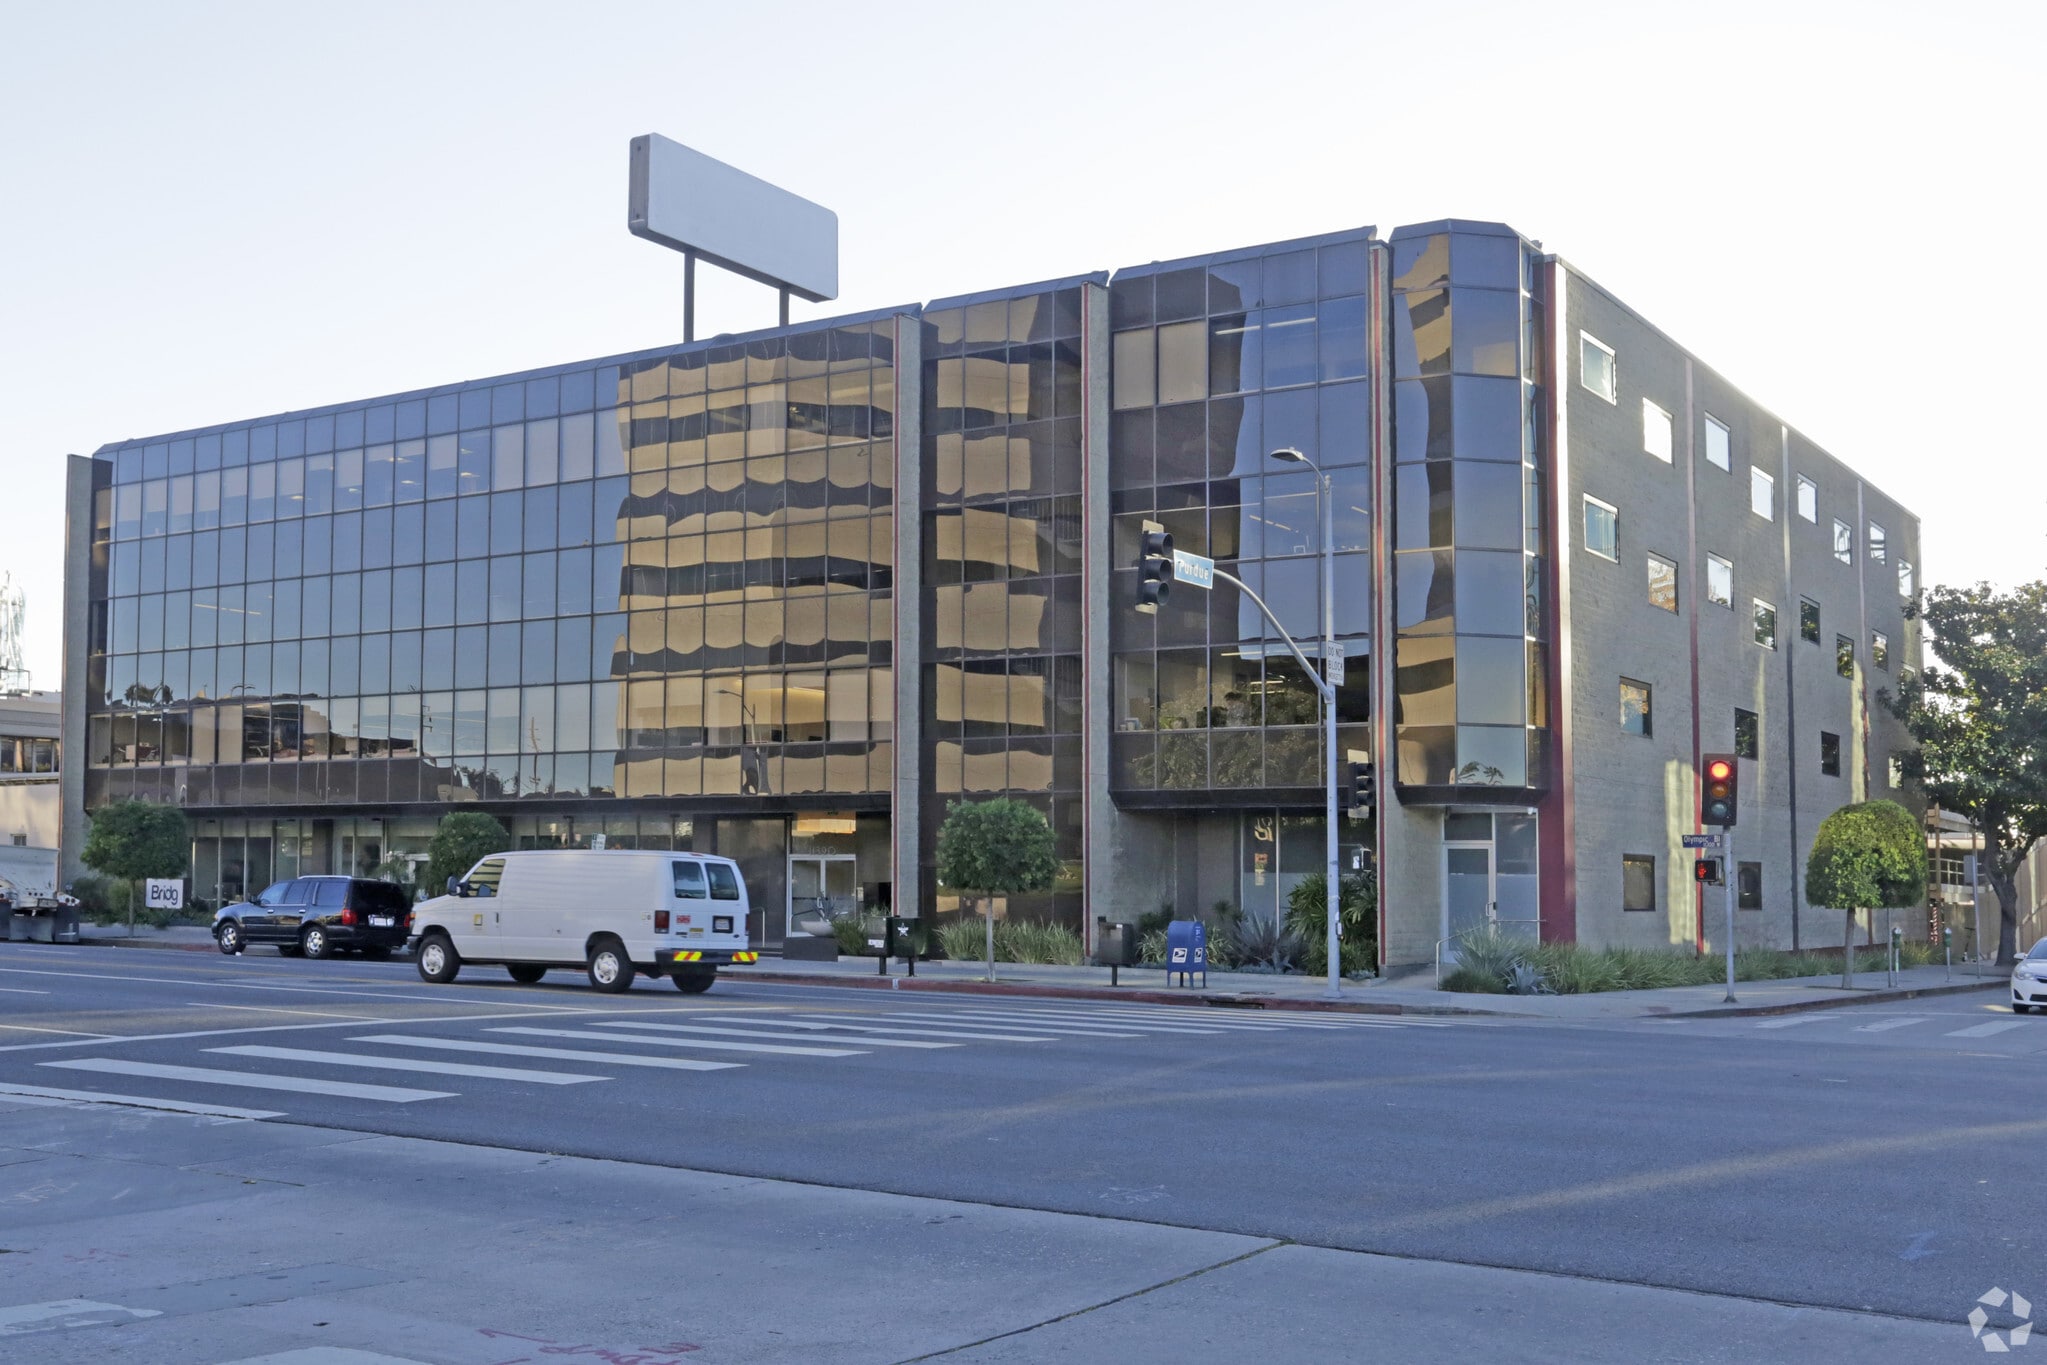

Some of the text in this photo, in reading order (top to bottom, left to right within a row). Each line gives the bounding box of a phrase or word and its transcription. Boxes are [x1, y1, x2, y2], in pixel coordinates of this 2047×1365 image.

[1178, 560, 1209, 580] Purdue
[1328, 646, 1344, 658] DO NOT
[1328, 660, 1343, 672] BLOCK
[1683, 835, 1708, 845] Olympic
[151, 884, 179, 906] Bridg
